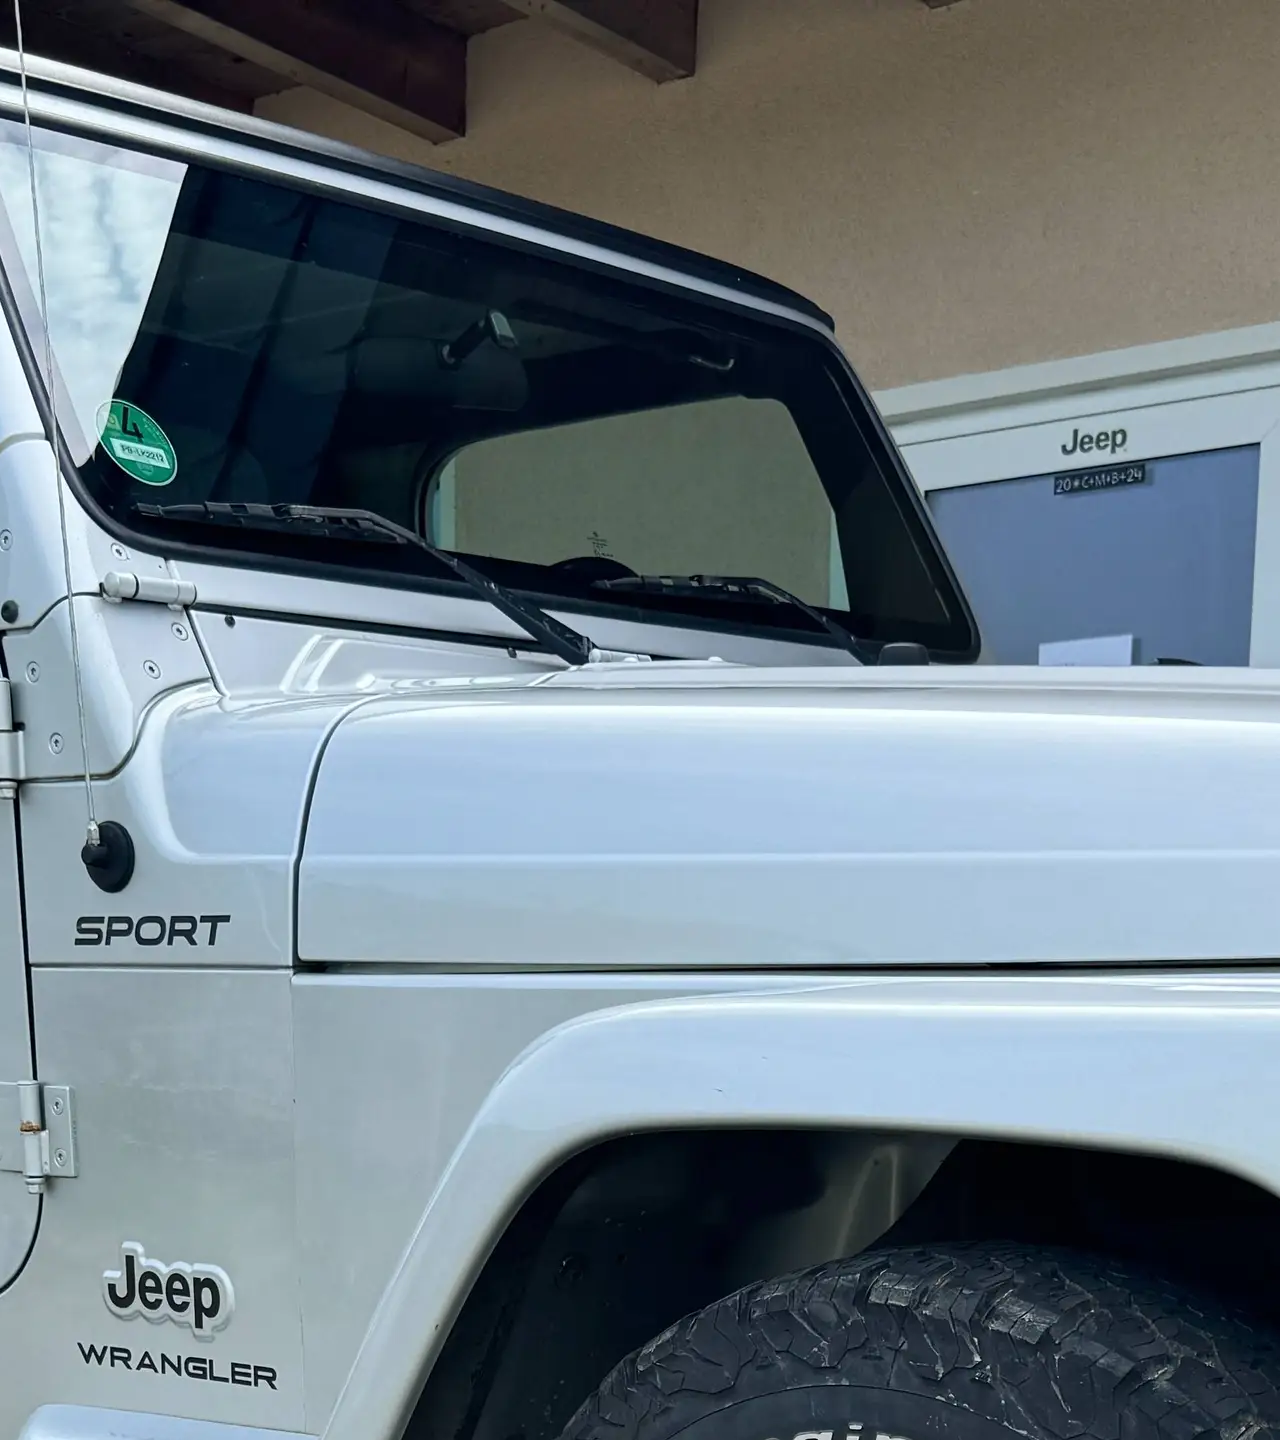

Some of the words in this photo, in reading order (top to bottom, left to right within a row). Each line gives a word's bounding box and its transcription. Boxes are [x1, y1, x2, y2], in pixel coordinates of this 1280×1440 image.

[122, 406, 144, 442] 4
[1061, 428, 1127, 456] Jeep
[74, 914, 232, 947] SPORT
[106, 1253, 222, 1329] Jeep
[76, 1341, 279, 1391] WRANGLER
